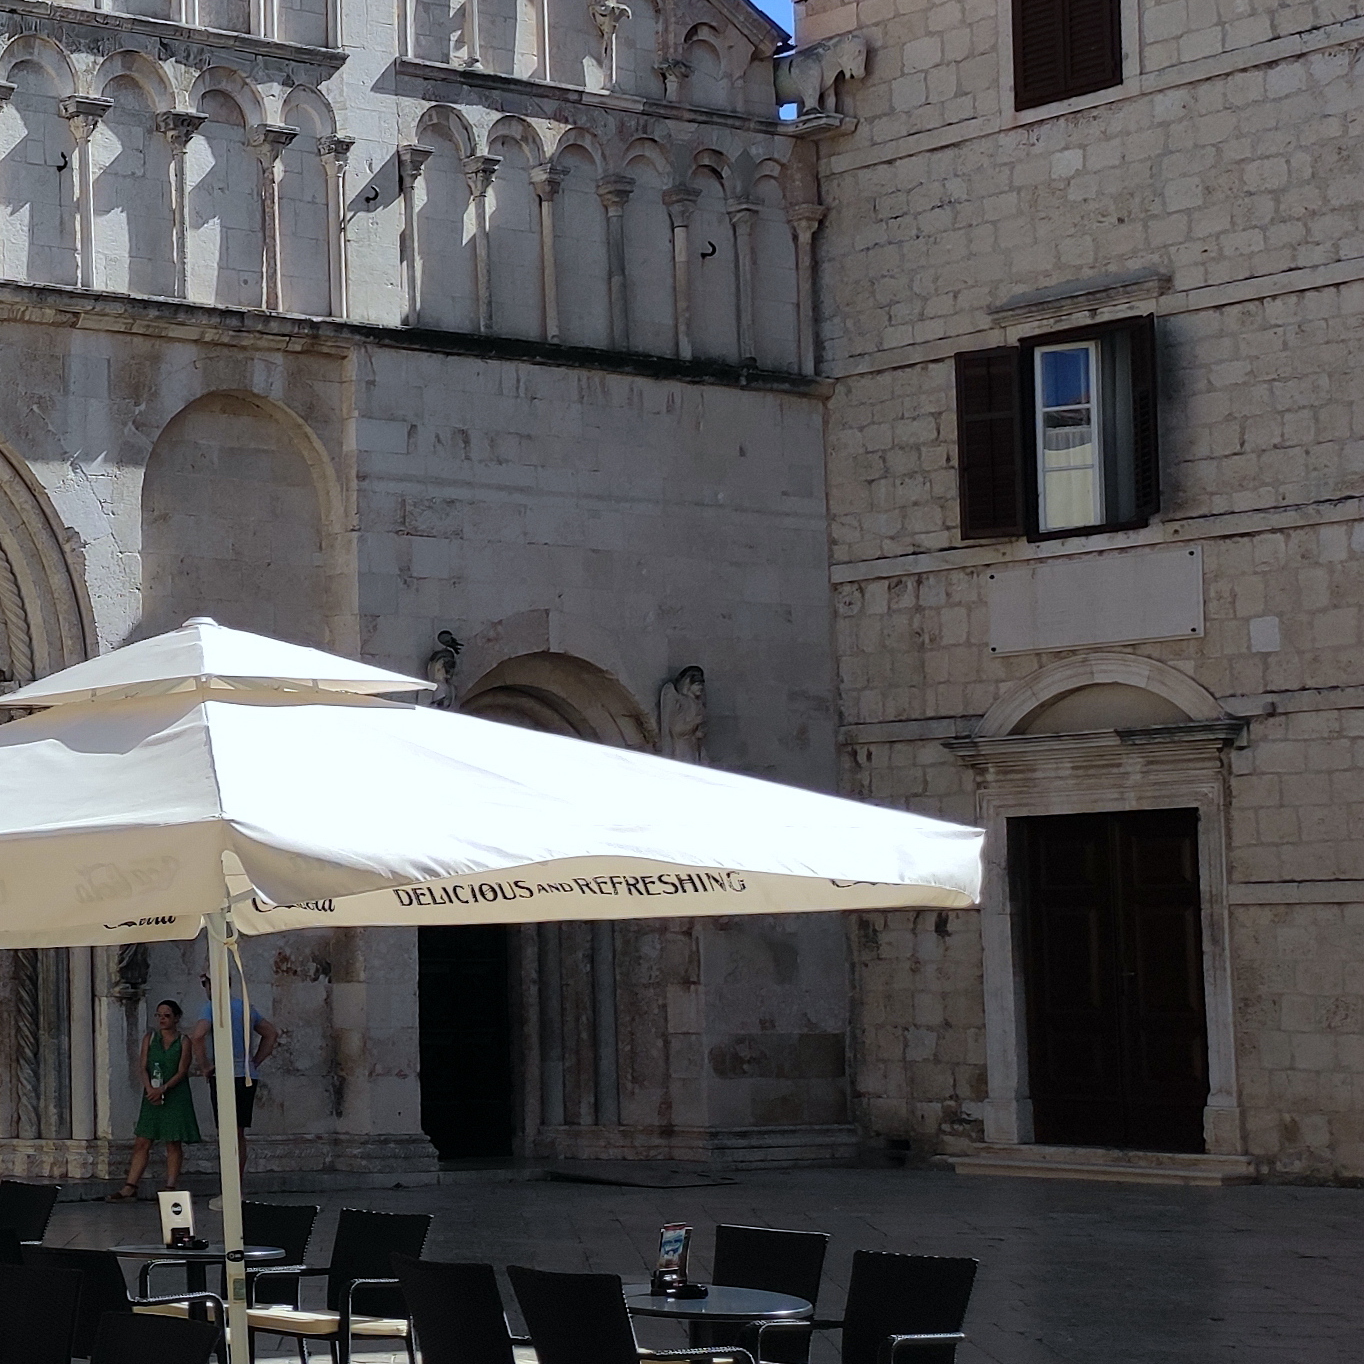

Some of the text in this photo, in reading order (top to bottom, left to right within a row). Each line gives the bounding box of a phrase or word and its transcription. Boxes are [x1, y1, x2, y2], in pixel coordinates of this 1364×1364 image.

[392, 871, 747, 907] DELICIOUS AND REFRESHING
